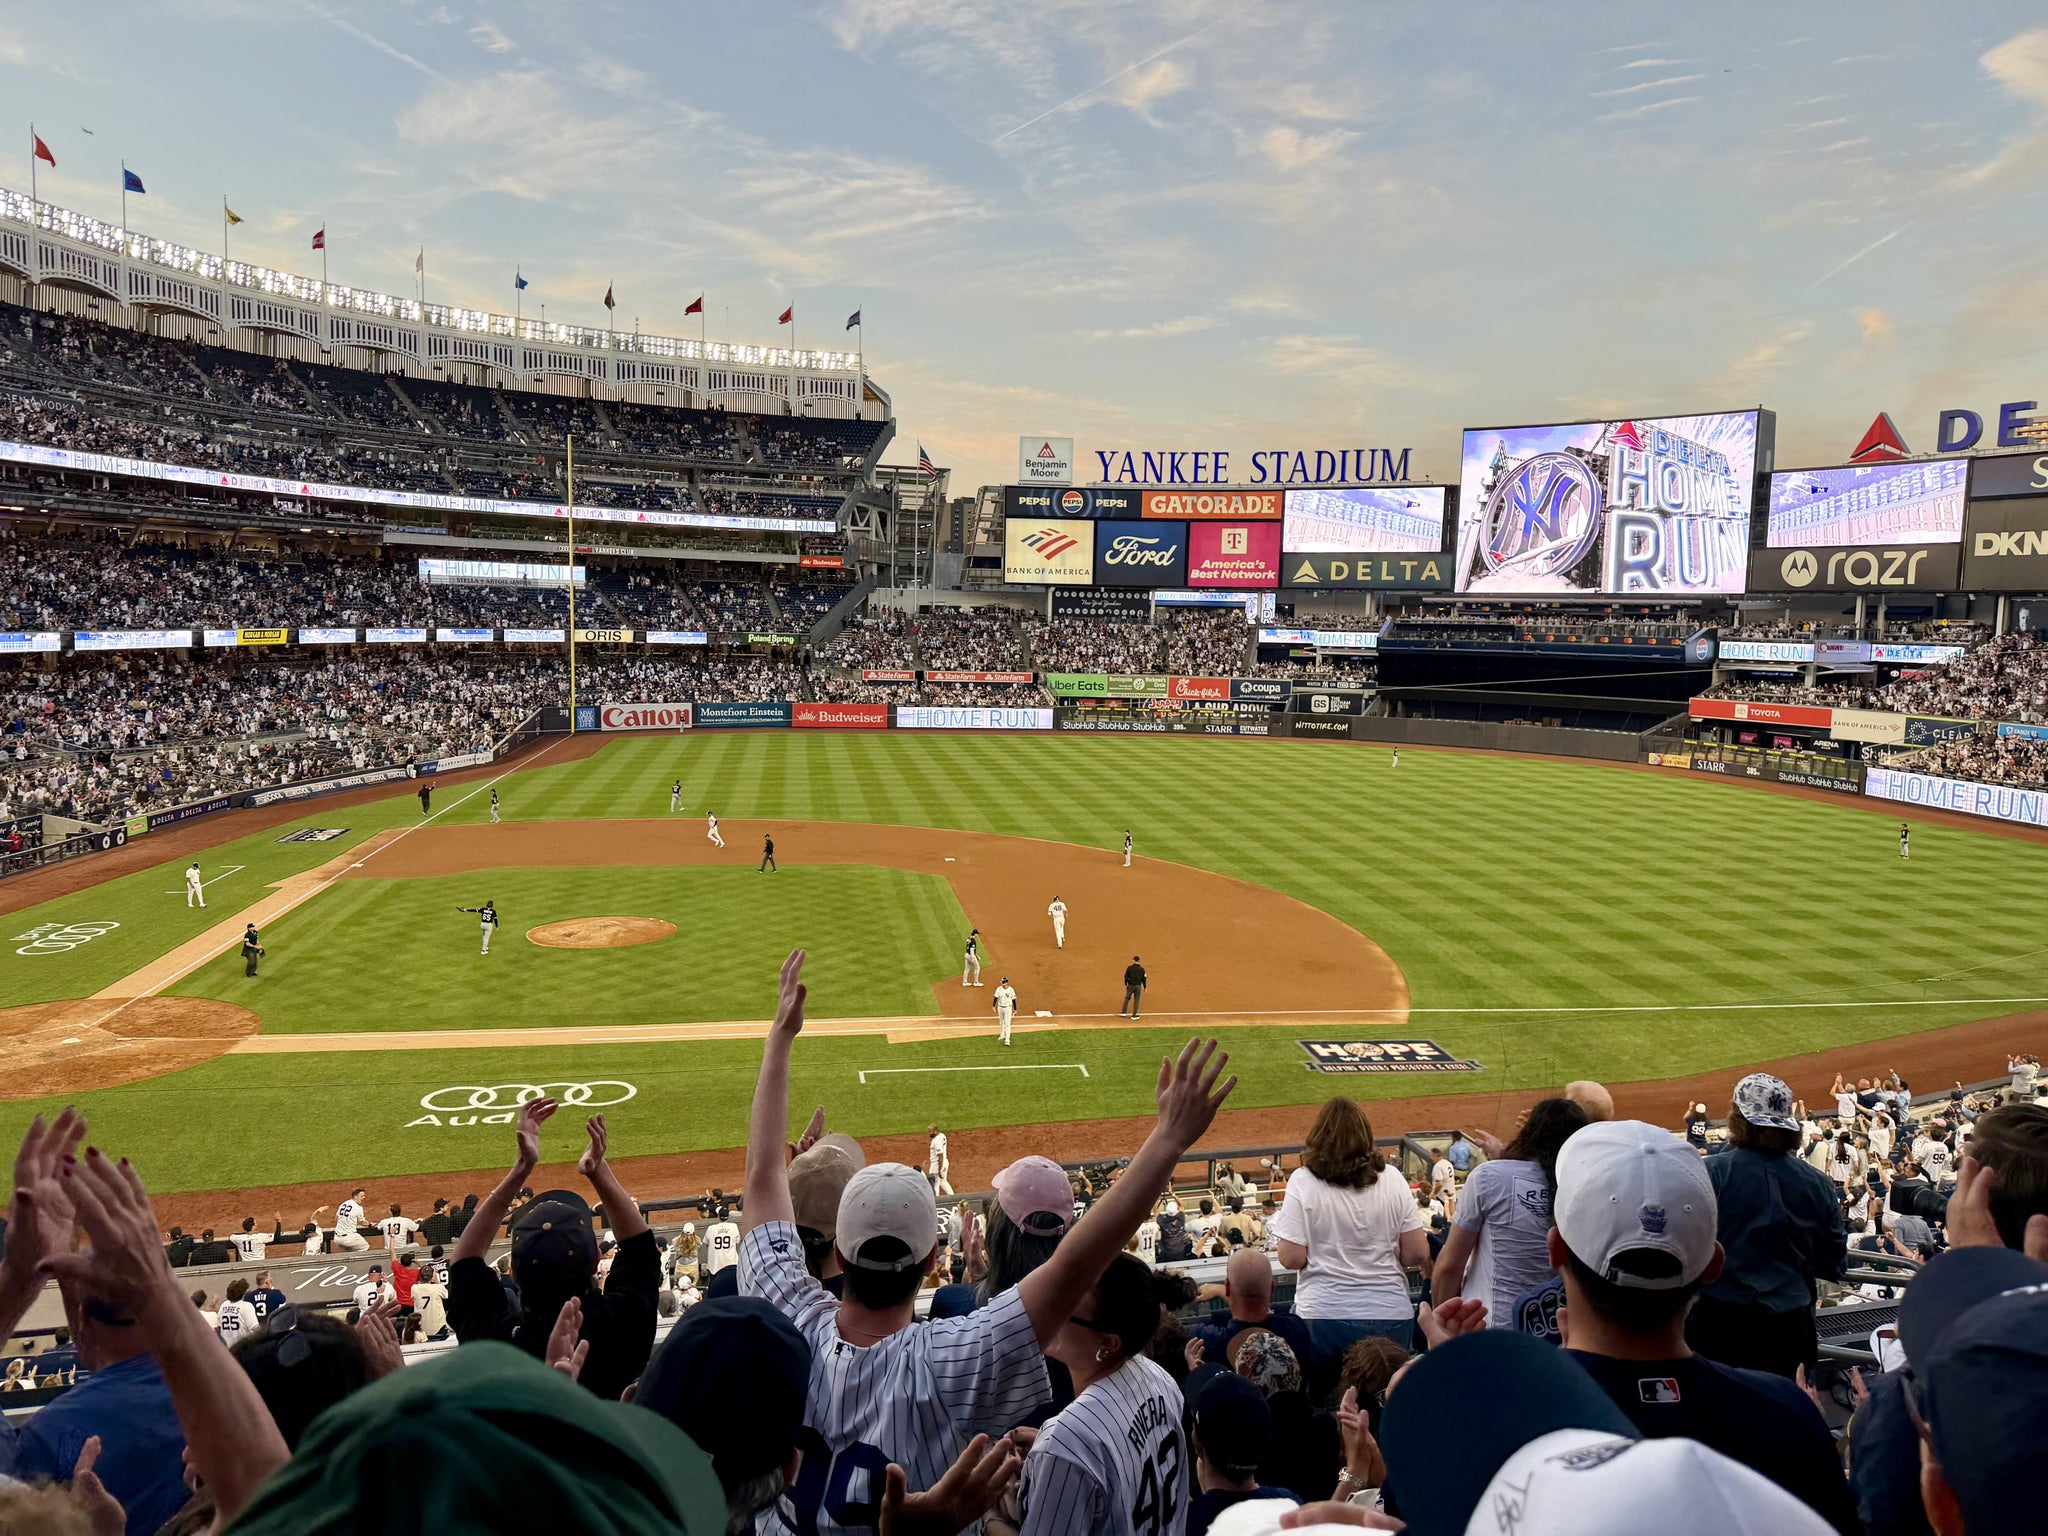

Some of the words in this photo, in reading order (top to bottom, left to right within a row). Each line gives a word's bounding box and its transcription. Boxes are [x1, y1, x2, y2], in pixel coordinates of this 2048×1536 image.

[1653, 431, 1730, 477] DELTA
[130, 460, 164, 478] RUN
[1025, 459, 1067, 470] Benjamin
[1095, 450, 1229, 484] YANKEE
[1250, 448, 1414, 484] STADIUM
[1030, 468, 1061, 478] Moore
[1614, 446, 1744, 519] HOME
[463, 498, 495, 512] RUN
[1019, 496, 1050, 507] PEPSI
[1063, 498, 1083, 506] PEPSI
[1096, 498, 1127, 508] PEPSI
[1150, 495, 1276, 514] GATORADE
[795, 520, 826, 532] RUN
[573, 546, 593, 554] Audi
[595, 547, 618, 555] YANKEES
[620, 548, 634, 556] CLUB
[1104, 535, 1178, 567] Ford
[1612, 511, 1745, 592] RUN
[445, 560, 508, 578] HOME
[516, 564, 561, 580] RUN
[1200, 559, 1265, 570] America's
[1330, 560, 1441, 581] DELTA
[1827, 550, 1929, 585] razr
[1006, 567, 1032, 575] BANK
[1048, 568, 1090, 576] AMERICA
[1190, 569, 1219, 579] Best
[1220, 569, 1276, 580] Network
[585, 630, 622, 642] ORIS
[748, 632, 771, 644] Poland
[771, 634, 794, 645] Spring
[1314, 632, 1351, 645] HOME
[1720, 643, 1764, 658] HOME
[1769, 645, 1805, 660] RUN
[1887, 649, 1923, 658] DELTA
[1050, 679, 1075, 691] Uber
[1078, 680, 1105, 692] Eats
[1253, 684, 1281, 695] coupa
[1314, 699, 1327, 708] GS
[602, 706, 690, 728] Canon
[701, 707, 748, 717] Montefiore
[749, 707, 784, 717] Einstein
[818, 711, 884, 724] Budweiser
[917, 709, 982, 727] HOME
[990, 710, 1037, 727] RUN
[1750, 708, 1781, 718] TOYOTA
[1063, 721, 1095, 730] StubHub
[1097, 721, 1130, 731] StubHub
[1132, 723, 1166, 732] StubHub
[1205, 724, 1233, 734] STARR
[1295, 720, 1349, 732] NITTOTIRE.COM
[1833, 720, 1850, 728] BANK
[1860, 723, 1888, 731] AMERICA
[1813, 740, 1840, 749] ARENA
[1697, 759, 1725, 773] STARR
[1778, 772, 1806, 783] StubHub
[1807, 776, 1832, 788] StubHub
[1833, 780, 1859, 791] StubHub
[212, 799, 228, 809] DELTA
[1889, 774, 1968, 811] HOME
[1976, 787, 2040, 824] RUN
[186, 807, 202, 817] DELTA
[157, 814, 175, 824] DELTA
[482, 913, 492, 922] 65
[1691, 1125, 1706, 1136] 99
[1932, 1152, 1946, 1164] 99
[339, 1203, 353, 1217] 22
[242, 1240, 253, 1253] 11
[714, 1235, 731, 1250] 99
[1143, 1237, 1152, 1251] 11
[420, 1295, 431, 1310] 7
[256, 1302, 267, 1317] 3
[222, 1315, 241, 1331] 25
[1127, 1395, 1169, 1451] RIVERA
[1131, 1430, 1181, 1536] 42
